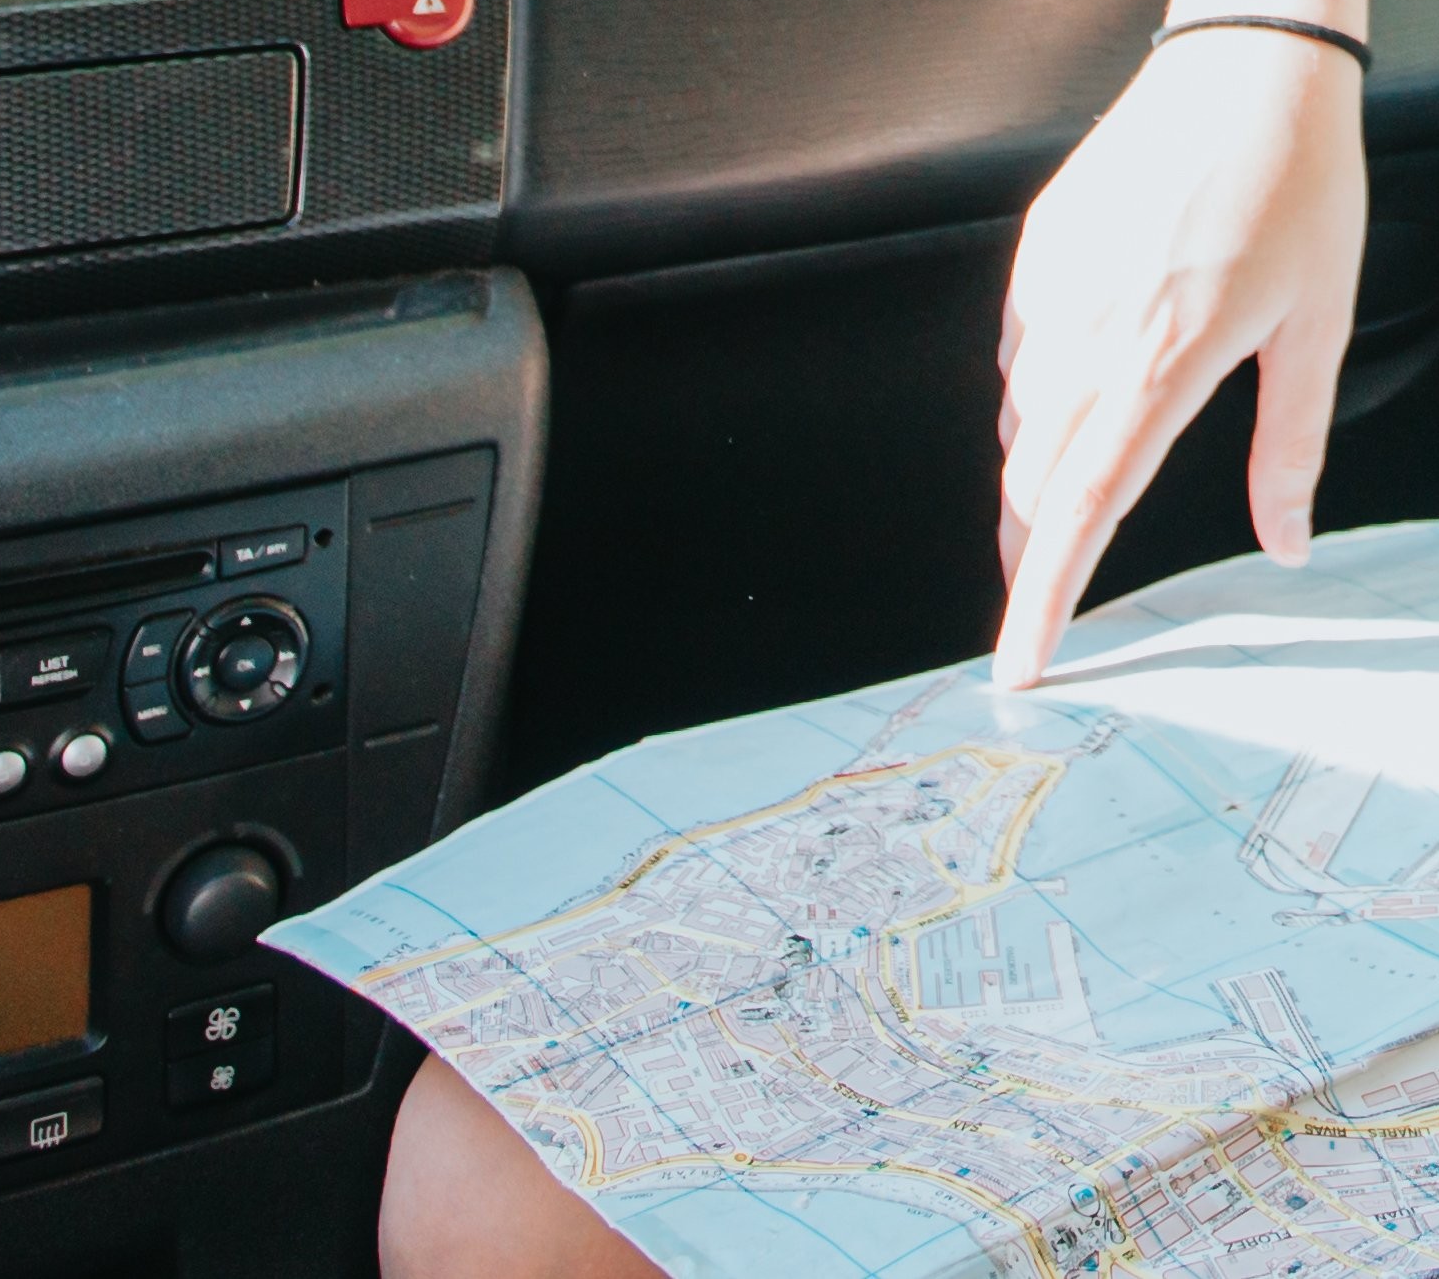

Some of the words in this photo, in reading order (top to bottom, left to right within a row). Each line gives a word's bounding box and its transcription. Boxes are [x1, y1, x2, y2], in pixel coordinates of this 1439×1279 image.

[40, 655, 71, 674] LIST
[948, 1120, 983, 1133] SAN
[1303, 1124, 1347, 1138] RIVAS
[1367, 1127, 1430, 1138] LINARES
[1374, 1206, 1416, 1222] JUAN
